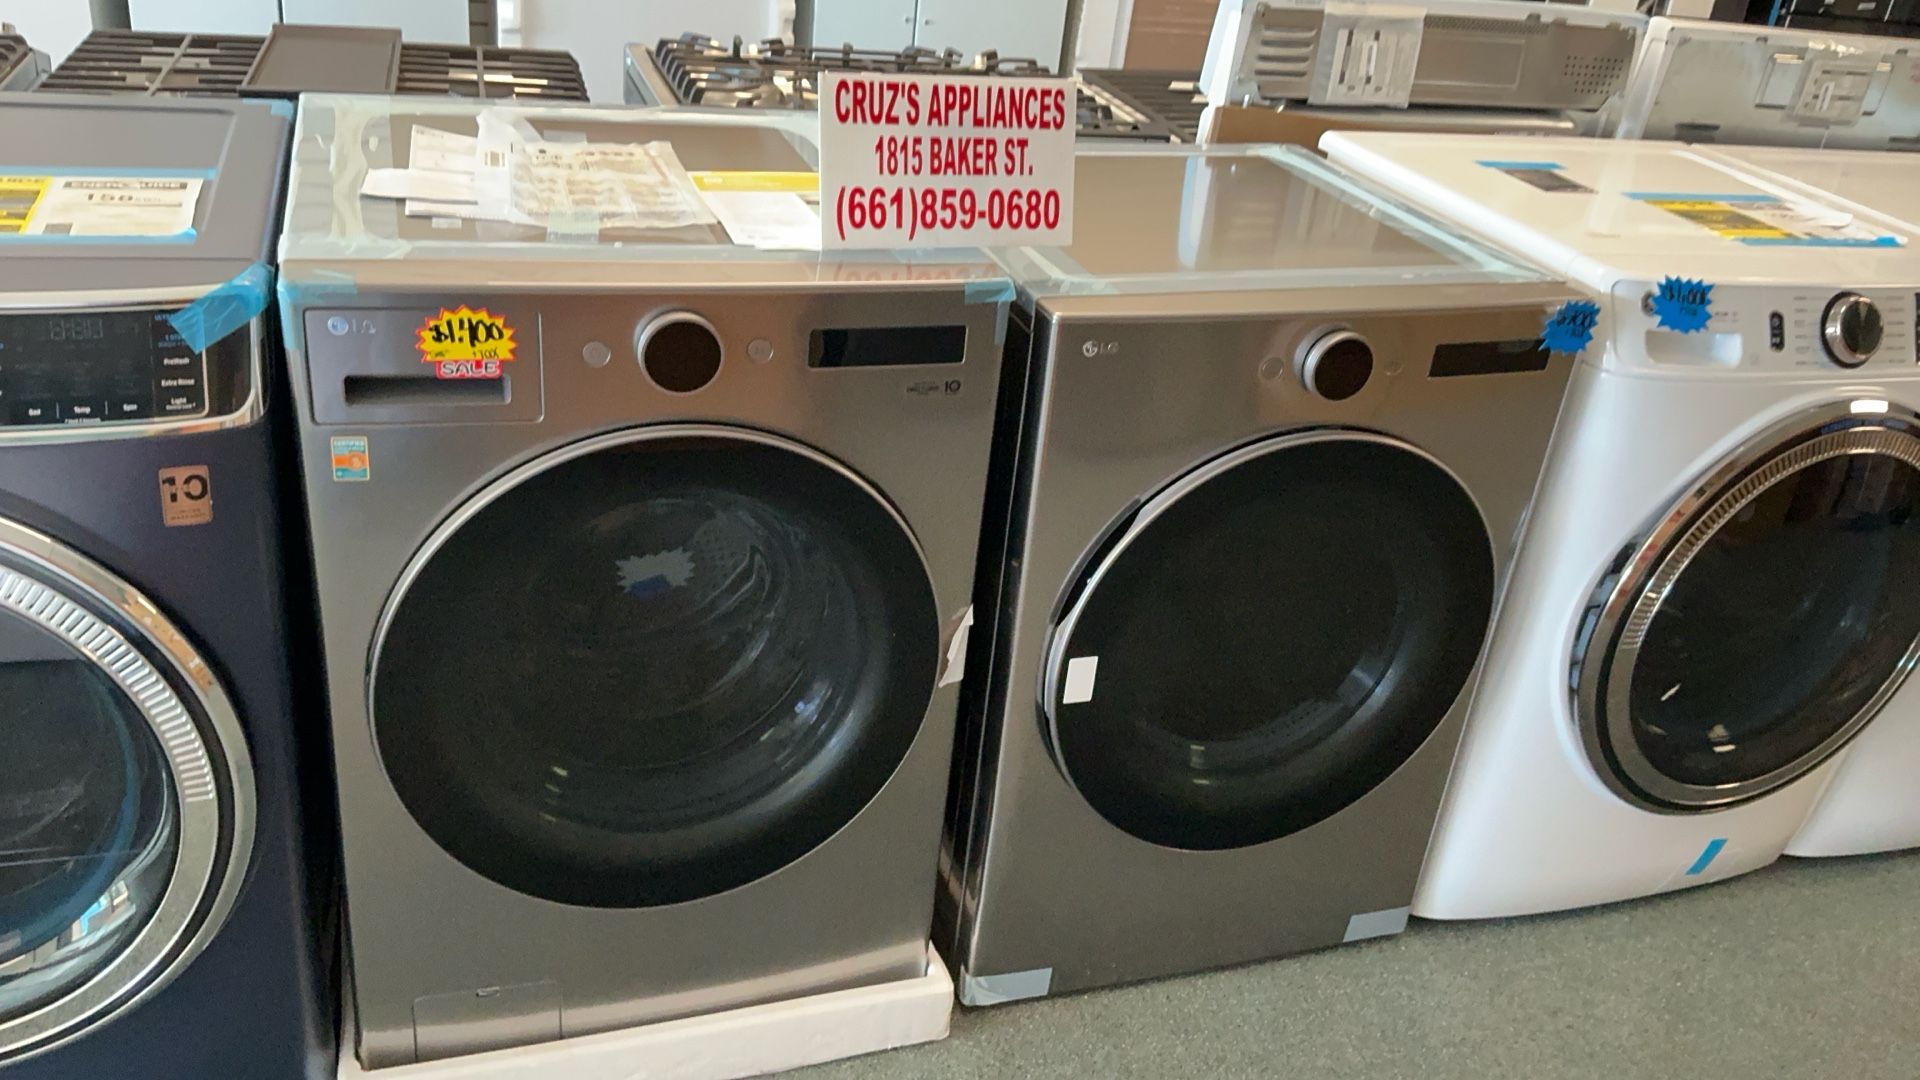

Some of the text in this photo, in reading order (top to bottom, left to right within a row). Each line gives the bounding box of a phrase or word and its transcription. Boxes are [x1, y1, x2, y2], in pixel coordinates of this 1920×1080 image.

[835, 79, 1066, 130] CRUZ'S APPLIANCES
[875, 135, 1034, 176] 1815 BAKER ST.
[836, 186, 1060, 241] (661)859-0680
[441, 360, 500, 376] SALE
[944, 379, 962, 393] 10
[161, 474, 209, 503] 10
